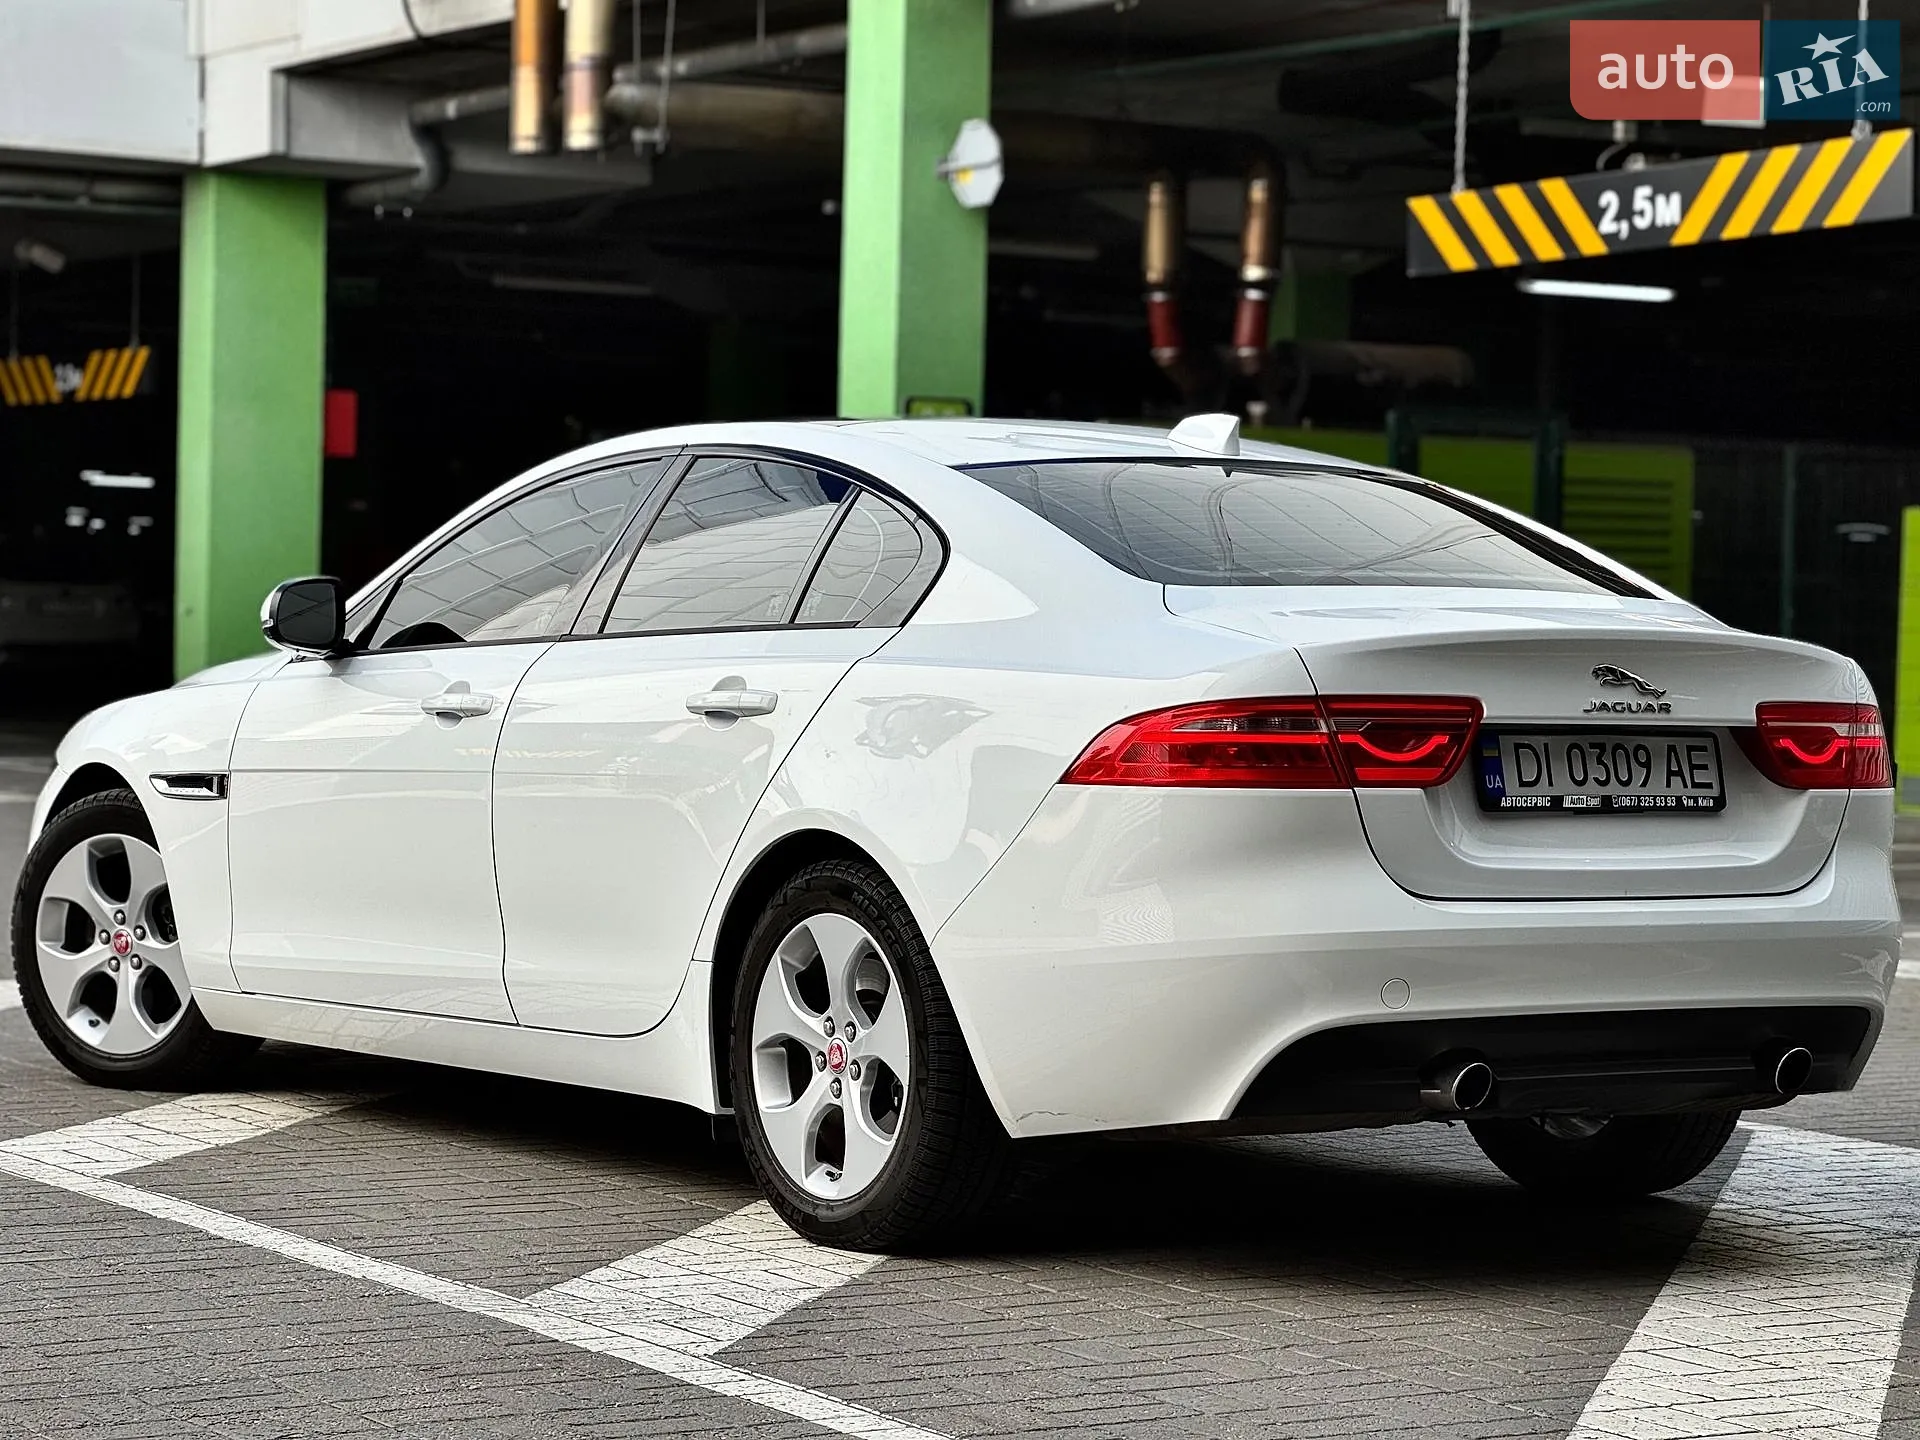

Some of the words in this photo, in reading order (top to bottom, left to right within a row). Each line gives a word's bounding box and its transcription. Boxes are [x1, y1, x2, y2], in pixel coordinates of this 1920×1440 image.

[1583, 701, 1672, 714] JAGUAR
[1513, 742, 1554, 788] DI
[1566, 742, 1652, 788] 0309
[1665, 744, 1713, 790] AE
[1486, 775, 1503, 789] UA
[1500, 797, 1551, 807] АВТОСЕРВІС
[1618, 797, 1638, 807] (067)
[1640, 797, 1654, 807] 325
[1655, 797, 1666, 807] 93
[1667, 797, 1676, 807] 93
[851, 890, 904, 960] MIRAGE
